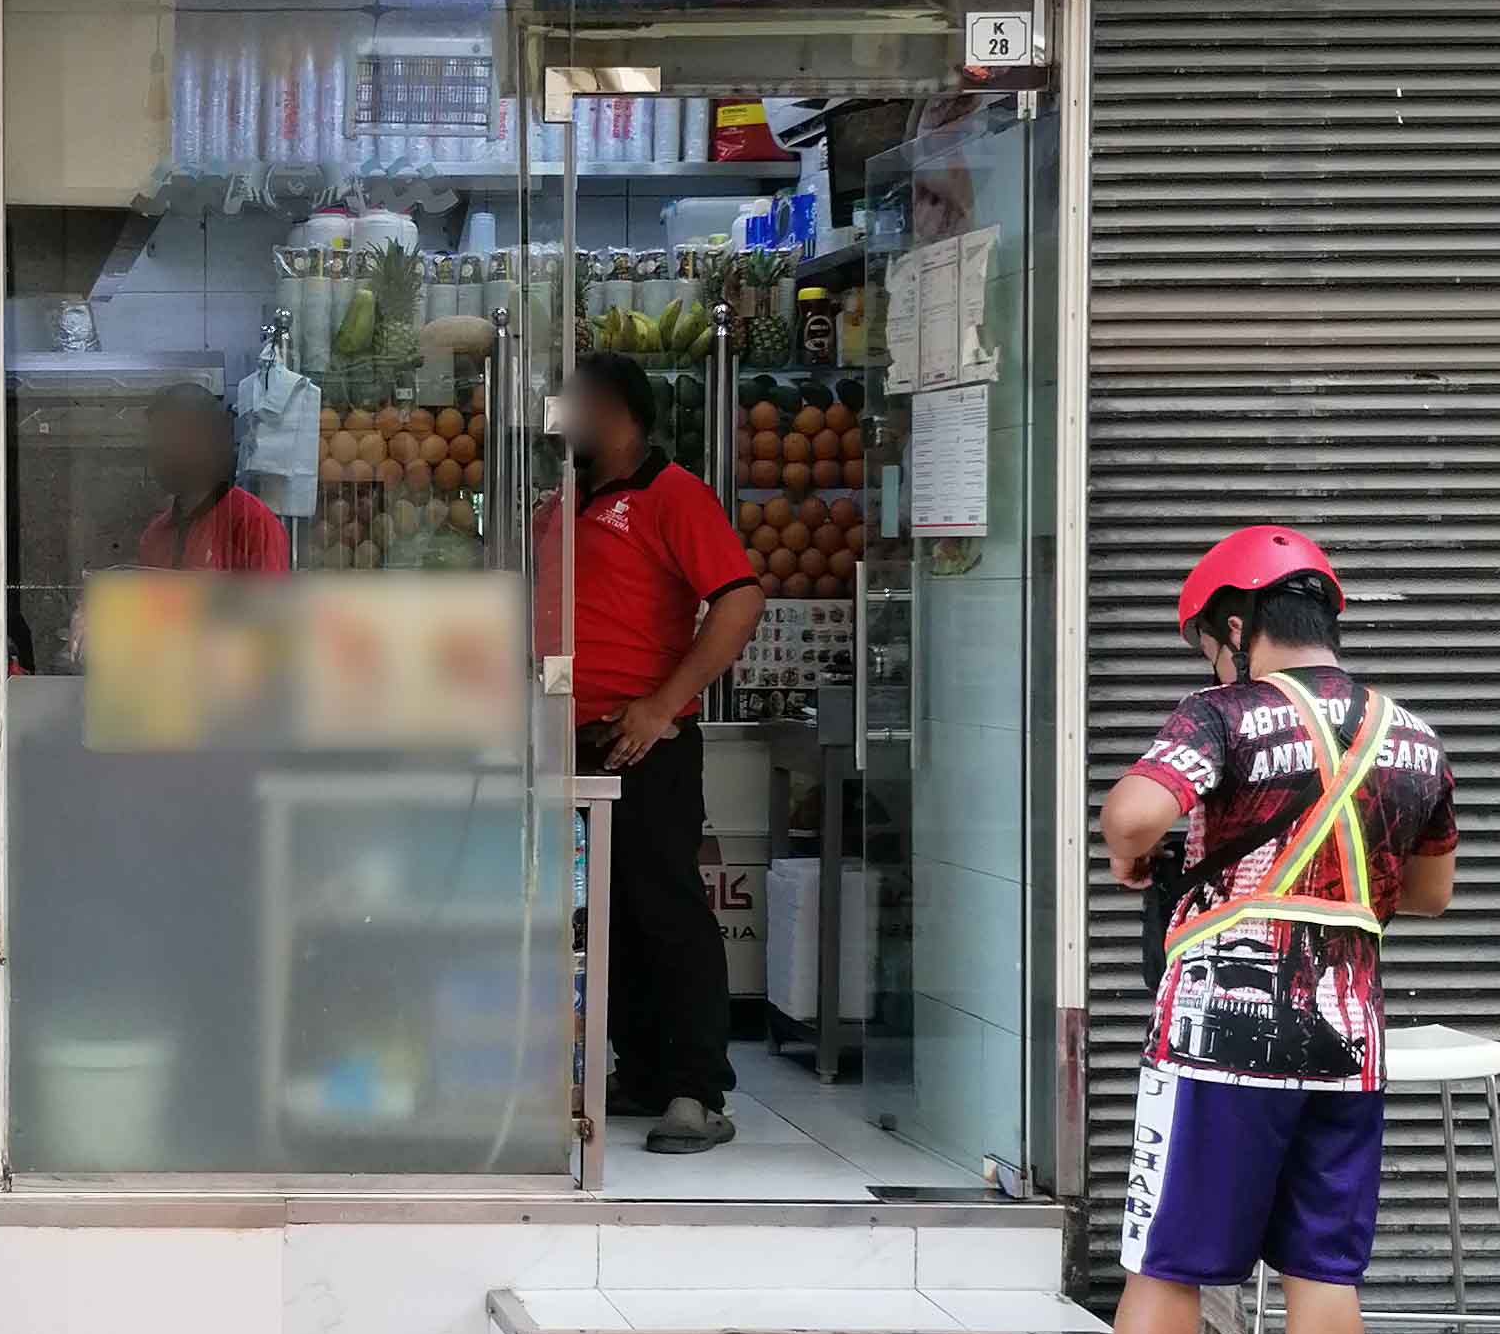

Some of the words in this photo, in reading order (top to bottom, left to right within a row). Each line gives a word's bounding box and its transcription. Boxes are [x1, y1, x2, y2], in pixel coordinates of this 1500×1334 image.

[993, 21, 1005, 36] K
[988, 38, 1009, 56] 28
[1125, 1123, 1164, 1241] DHABI
